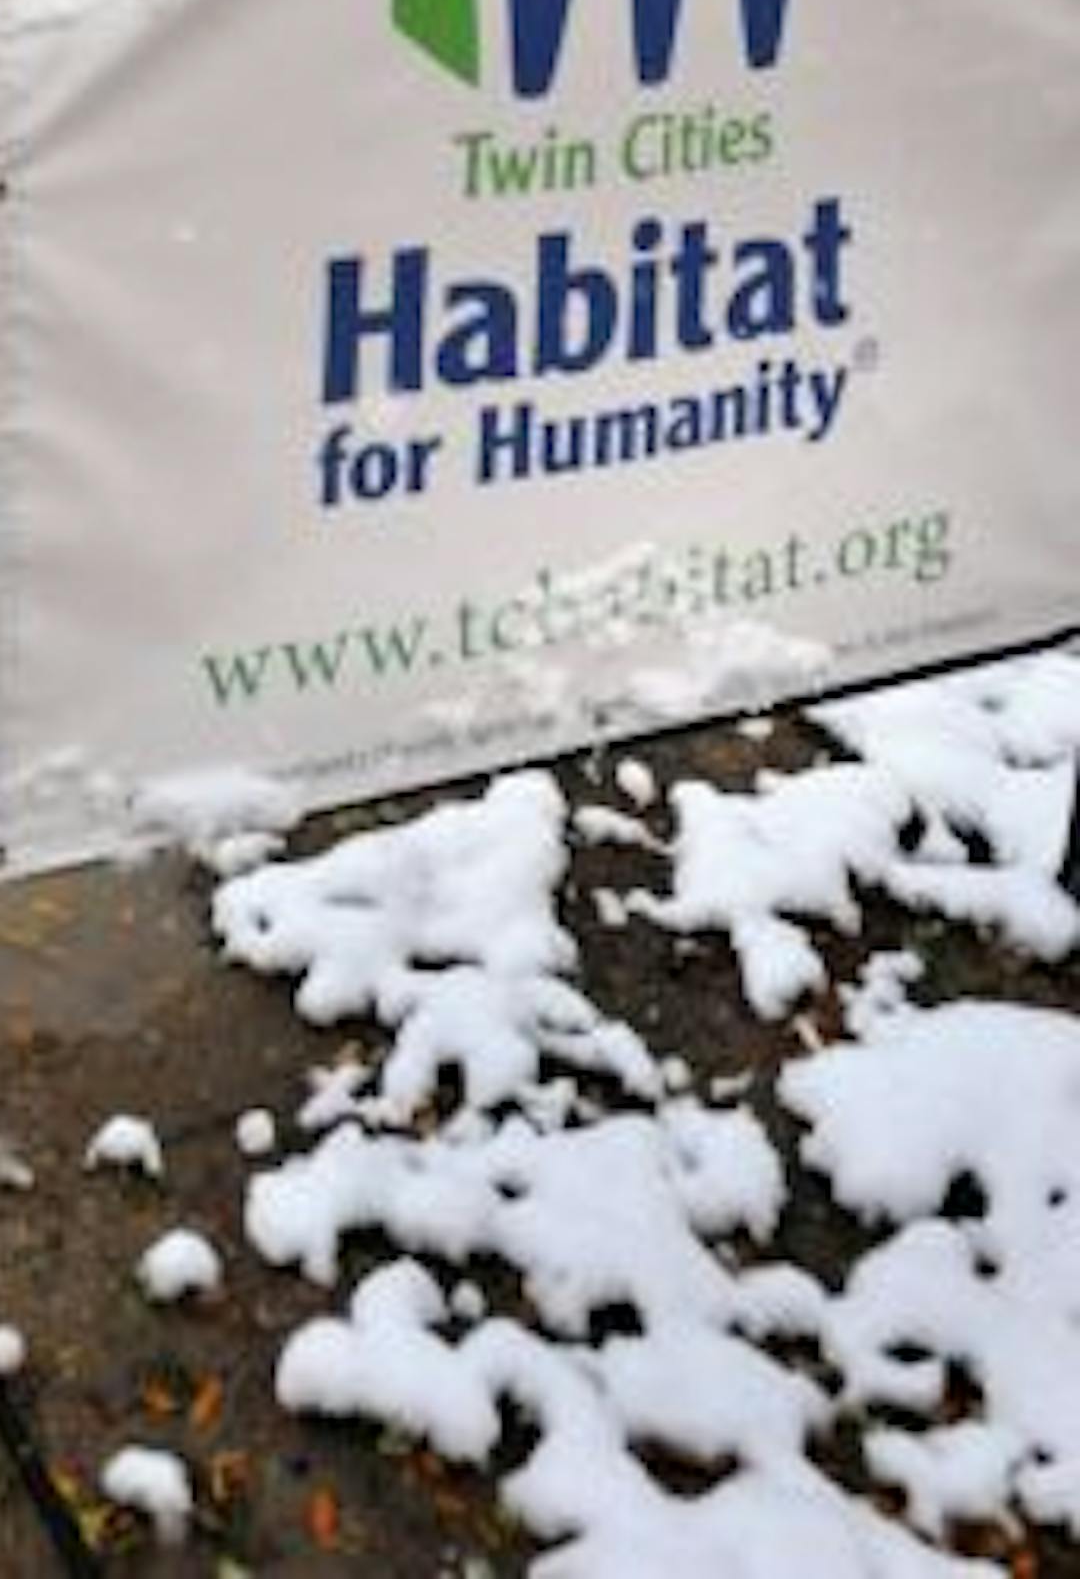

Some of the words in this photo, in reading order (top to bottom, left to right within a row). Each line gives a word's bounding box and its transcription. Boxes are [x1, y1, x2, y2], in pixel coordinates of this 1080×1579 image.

[456, 129, 596, 198] Twin
[622, 110, 773, 180] Cities
[321, 198, 851, 403] Habitat
[317, 425, 441, 506] for
[476, 360, 849, 484] Humanity
[202, 509, 950, 707] www.tcbitat.org
